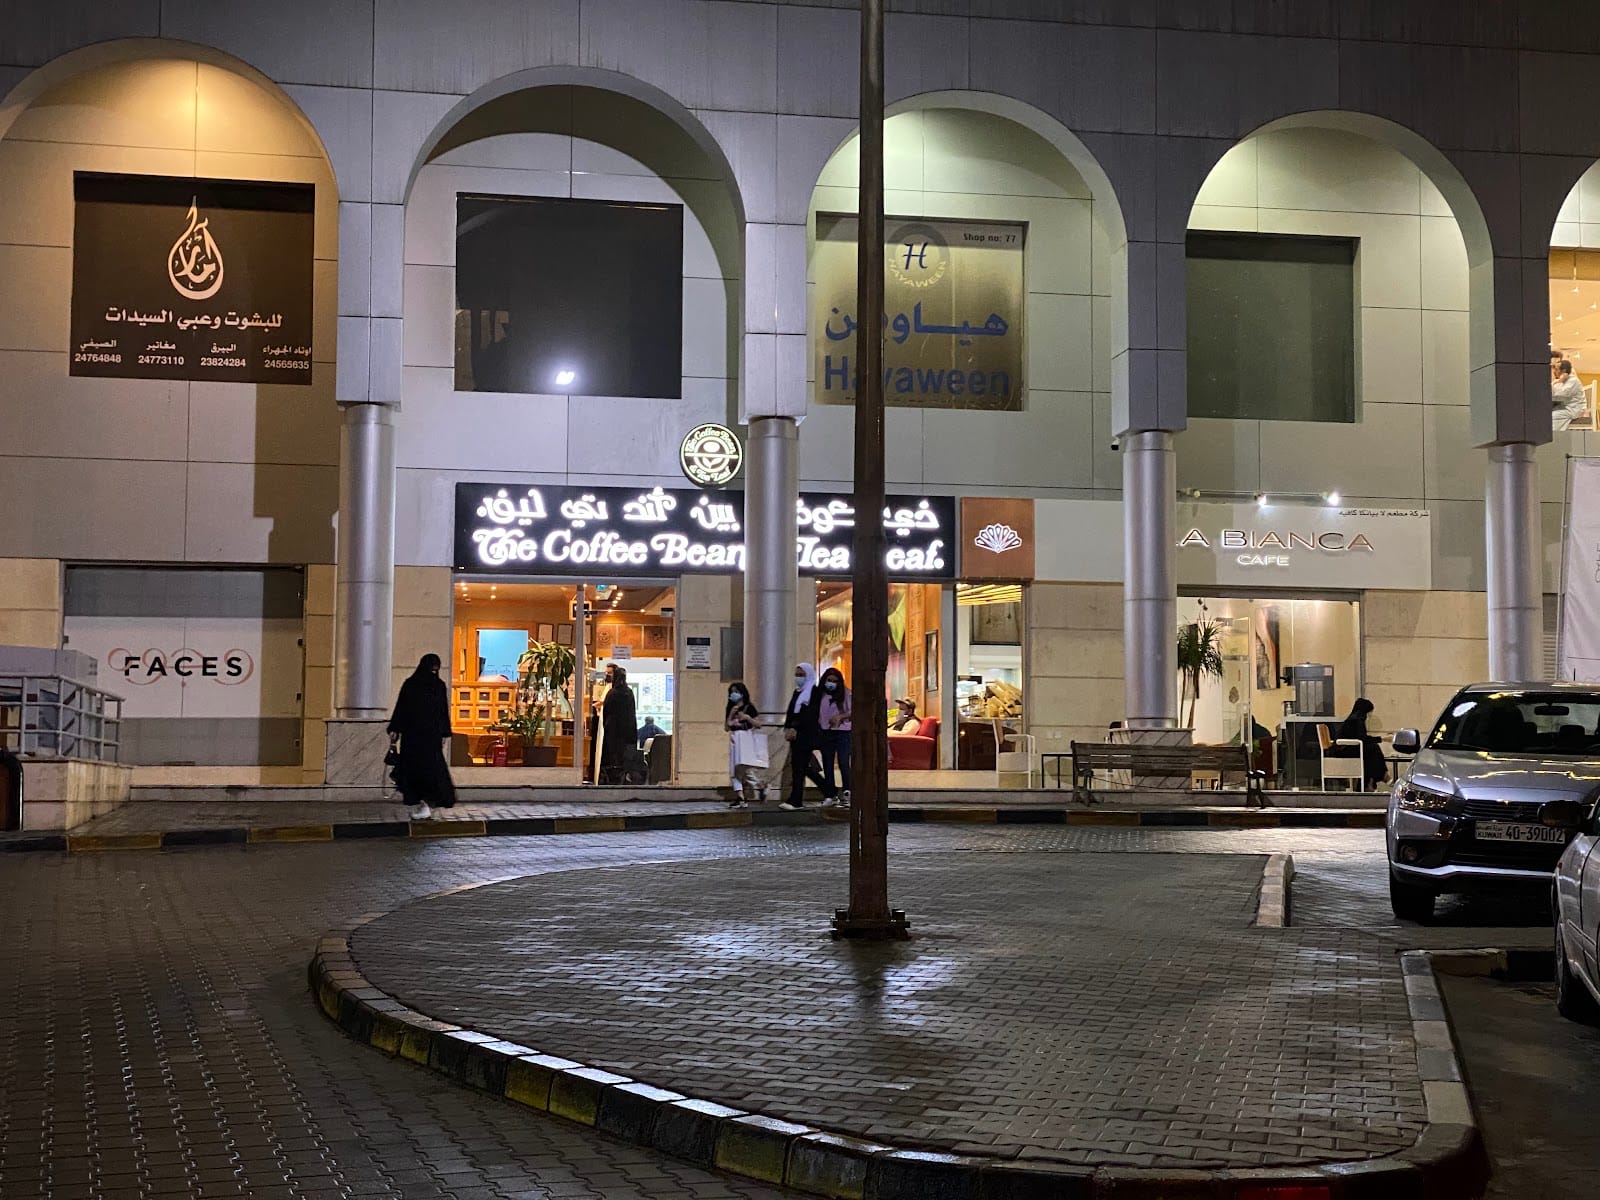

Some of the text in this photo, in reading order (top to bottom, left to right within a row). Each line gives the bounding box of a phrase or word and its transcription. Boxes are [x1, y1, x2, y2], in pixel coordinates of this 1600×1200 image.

[963, 232, 985, 242] Shop
[1005, 234, 1016, 243] 77
[887, 258, 946, 288] HAYAWEEN
[105, 306, 283, 332] للبشوت وعبي السيدات
[826, 301, 1008, 346] هياون
[74, 353, 122, 364] 24764848
[138, 355, 185, 365] 24773110
[200, 357, 246, 367] 23824284
[825, 354, 1009, 396] Haween
[694, 427, 721, 439] Coffee
[690, 495, 741, 532] بين
[473, 527, 945, 572] The Coffee Bean Tea eaf.
[1222, 529, 1375, 551] BIANCA
[1237, 554, 1290, 567] CAFE
[124, 656, 243, 677] FACES
[1477, 831, 1502, 839] KUWAIT
